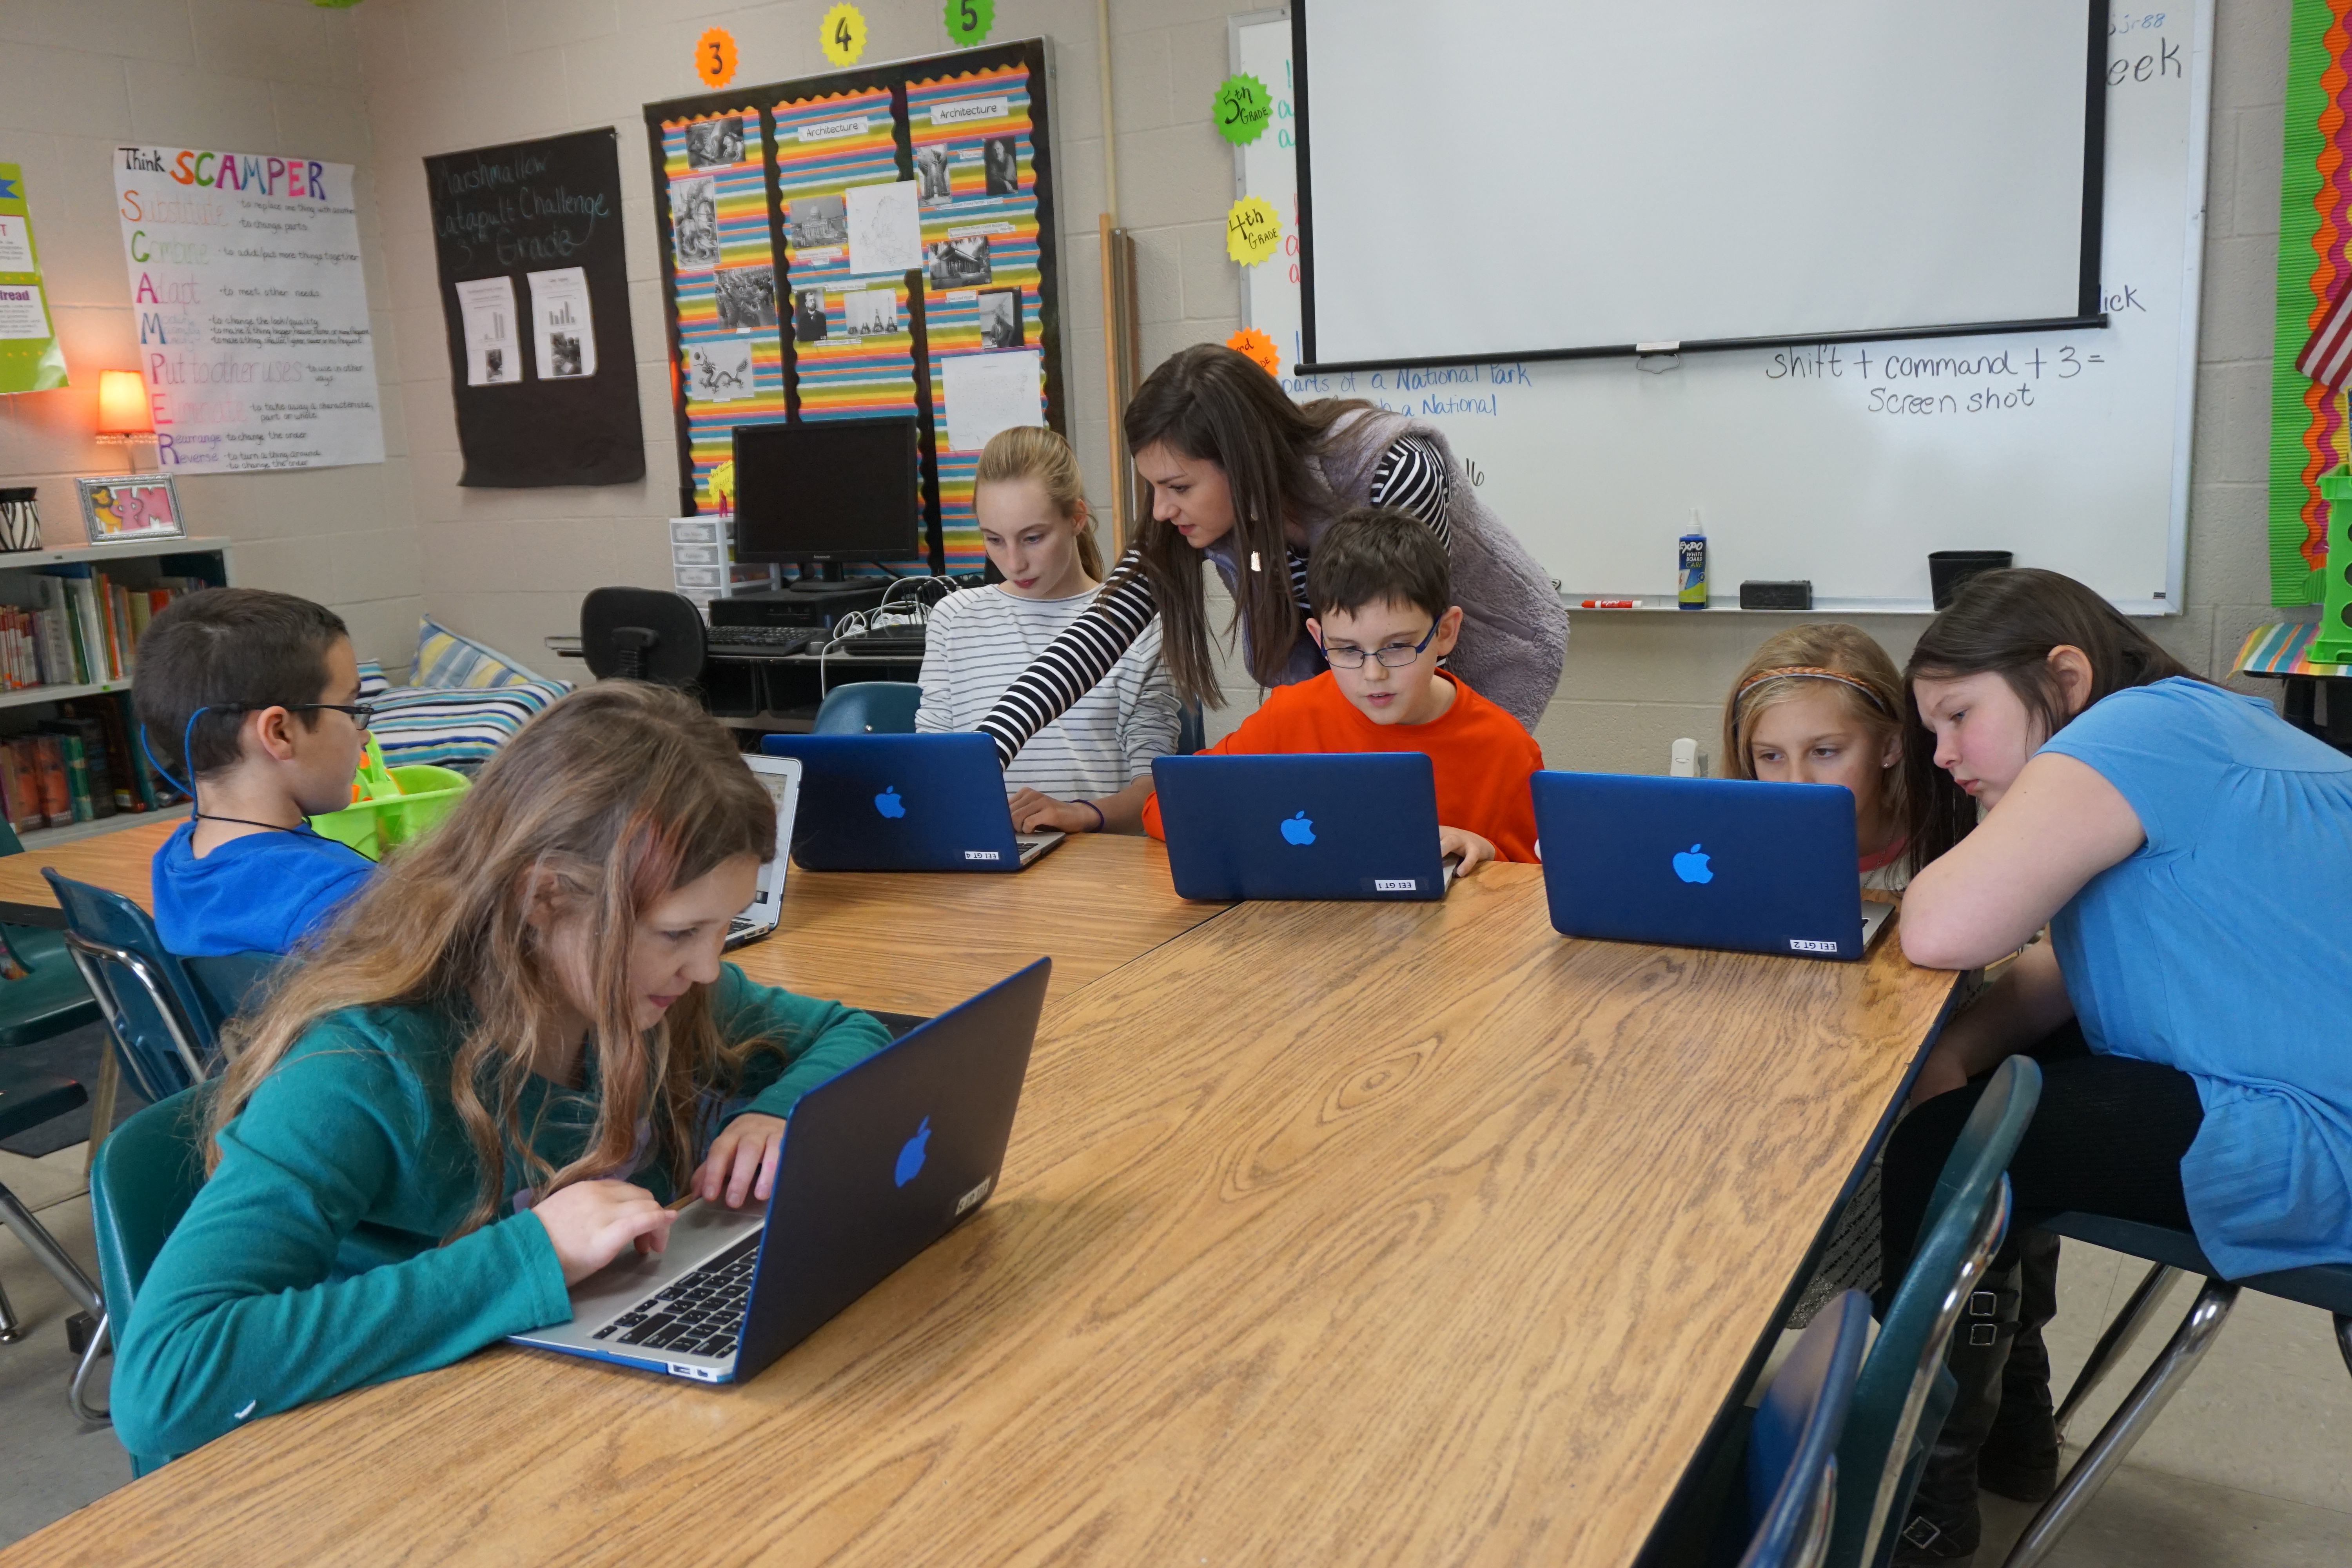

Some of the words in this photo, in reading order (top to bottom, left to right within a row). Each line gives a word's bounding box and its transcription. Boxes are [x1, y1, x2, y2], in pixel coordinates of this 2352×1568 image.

[960, 0, 978, 31] 5
[835, 17, 851, 51] 4
[708, 41, 722, 74] 3
[940, 104, 997, 119] Architecture
[1223, 86, 1253, 124] 5th
[1240, 107, 1269, 124] GRADE
[807, 122, 858, 138] Architecture
[118, 147, 165, 172] Think
[169, 150, 325, 200] SCAMPER
[520, 185, 609, 245] Challenge
[1229, 209, 1264, 240] 4th
[1249, 228, 1278, 249] GRADE
[151, 353, 185, 384] Put
[212, 353, 259, 383] other
[263, 361, 301, 383] uses
[1372, 373, 1387, 389] a
[1396, 364, 1479, 390] National
[1766, 347, 1842, 379] shift
[1886, 350, 2018, 379] command
[1423, 394, 1497, 416] National
[1679, 541, 1703, 554] EXPO
